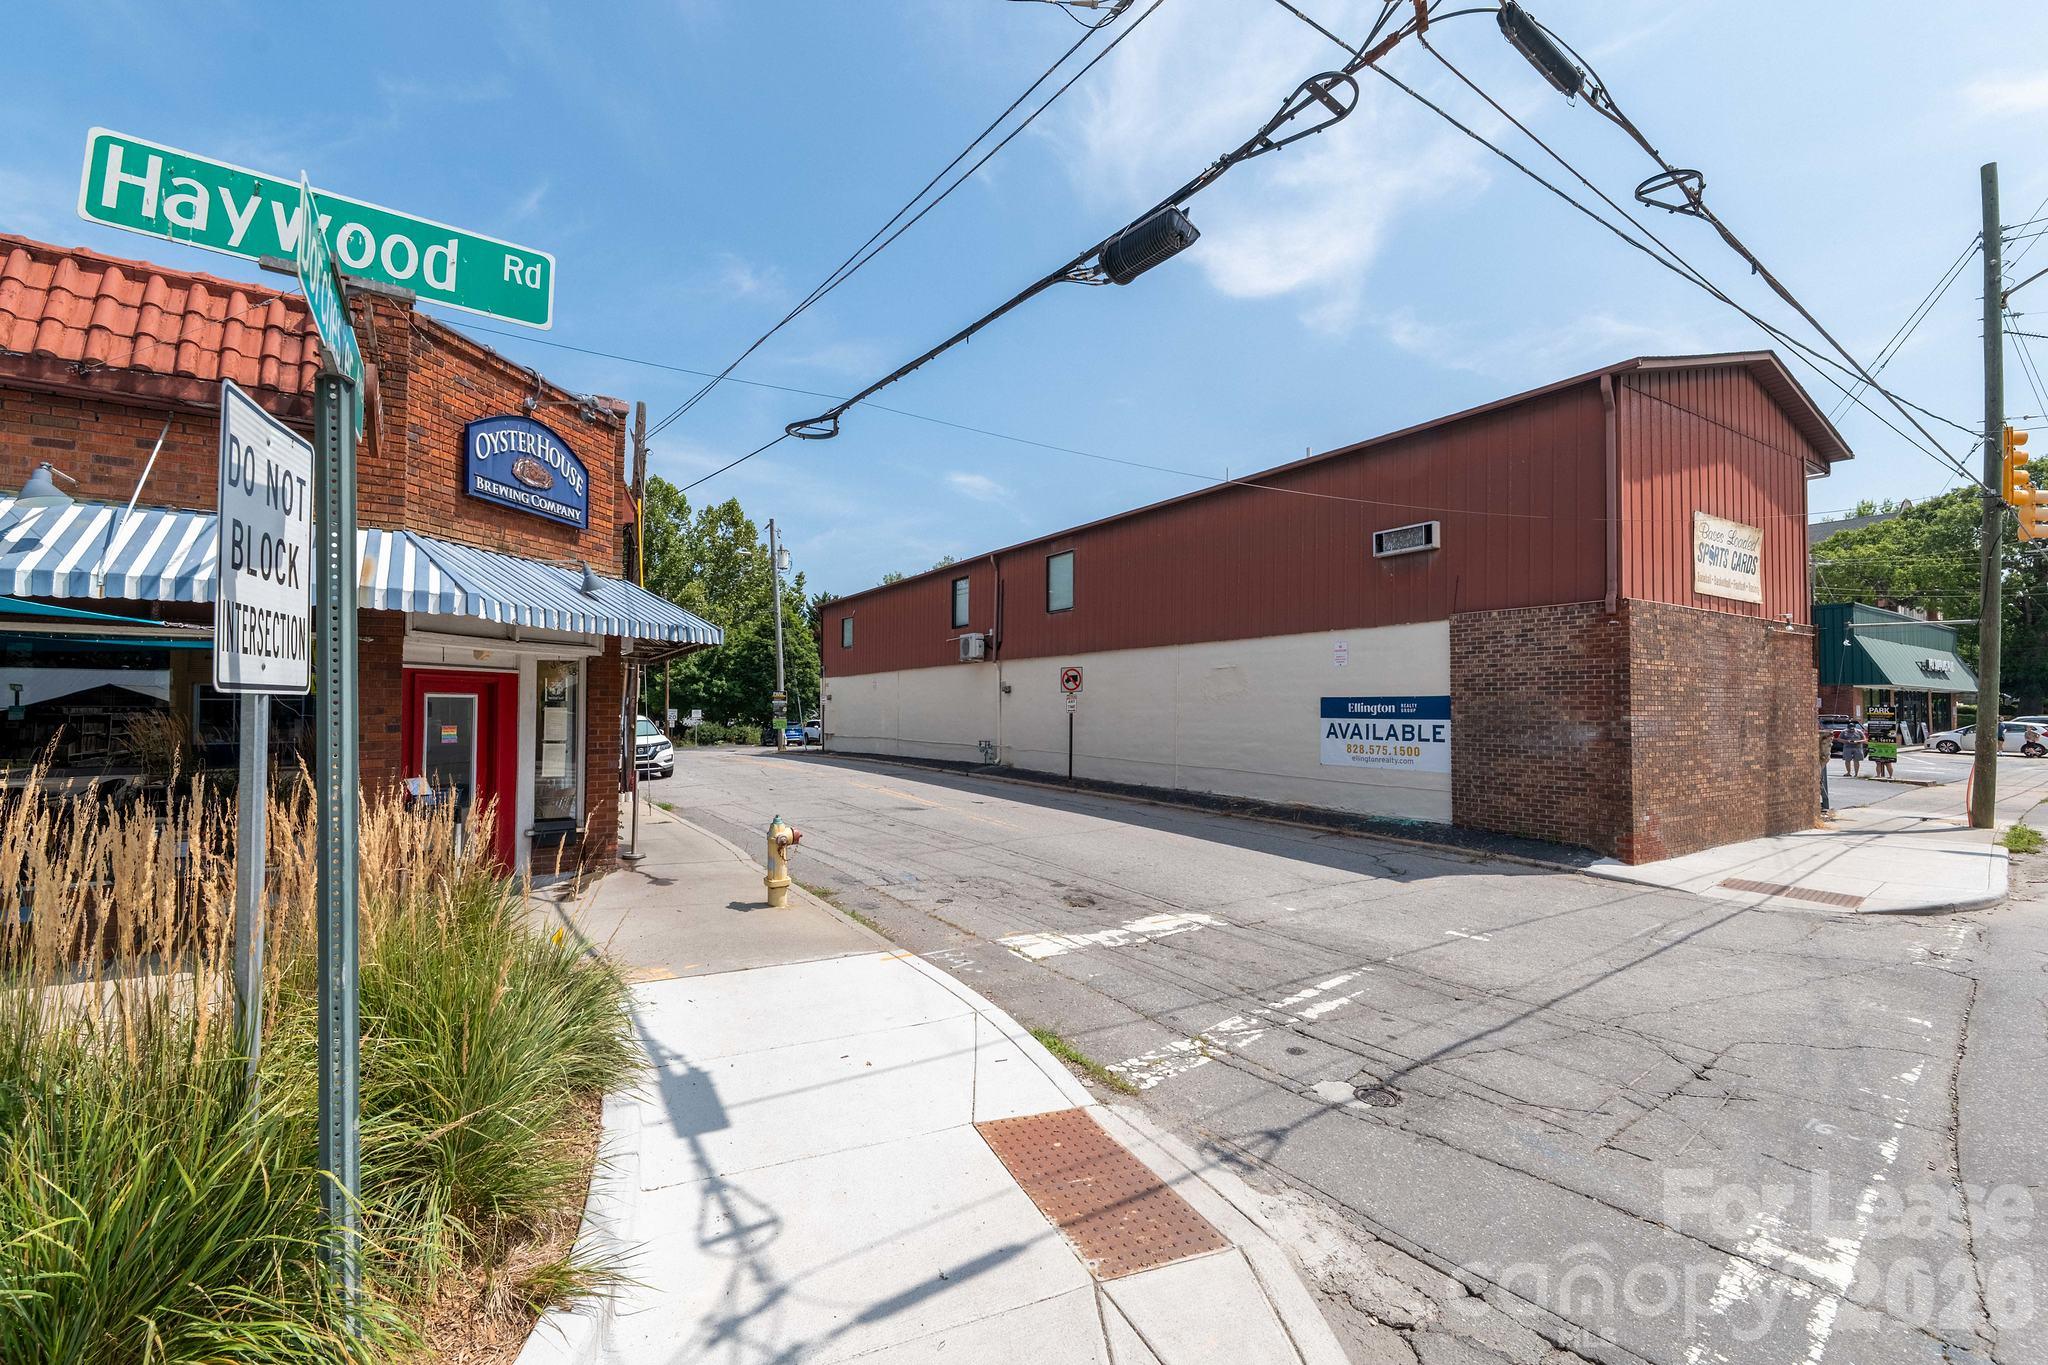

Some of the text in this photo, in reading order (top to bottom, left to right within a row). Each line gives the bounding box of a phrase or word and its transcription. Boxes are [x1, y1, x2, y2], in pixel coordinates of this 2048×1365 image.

[503, 253, 542, 290] Rd
[228, 433, 306, 521] DO NOT
[476, 476, 581, 520] BREWING COMPANY
[1699, 522, 1724, 544] Bases
[231, 518, 299, 590] BLOCK
[1731, 550, 1758, 575] CARDS
[222, 600, 306, 660] INTERSECTION
[1348, 702, 1396, 715] Ellington
[1326, 723, 1446, 743] AVAILABLE
[1346, 744, 1421, 757] 828.575.1500
